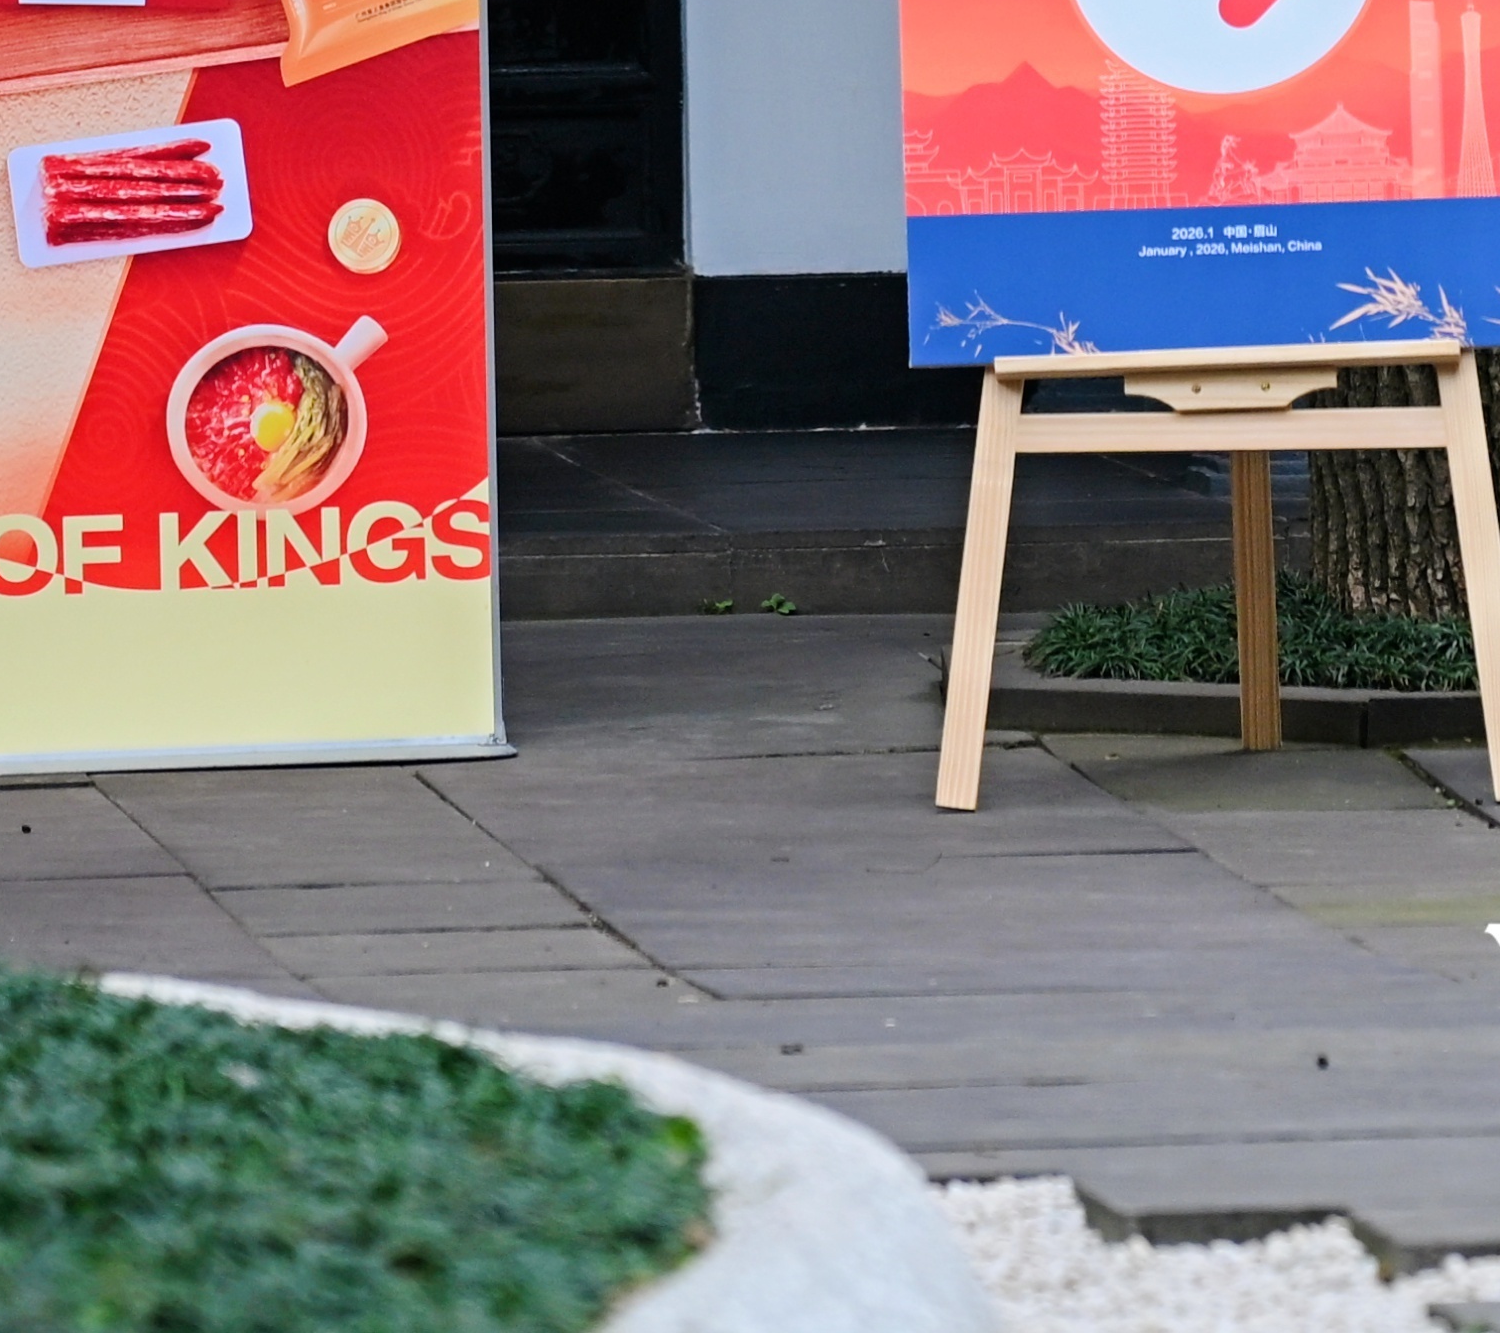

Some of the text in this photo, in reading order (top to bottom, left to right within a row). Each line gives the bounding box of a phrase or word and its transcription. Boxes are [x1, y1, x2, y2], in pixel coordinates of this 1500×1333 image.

[1172, 227, 1214, 240] 2026.1
[1196, 243, 1229, 256] 2026,
[1231, 240, 1285, 255] Meishan,
[1287, 239, 1322, 252] China
[160, 498, 492, 591] KINGS
